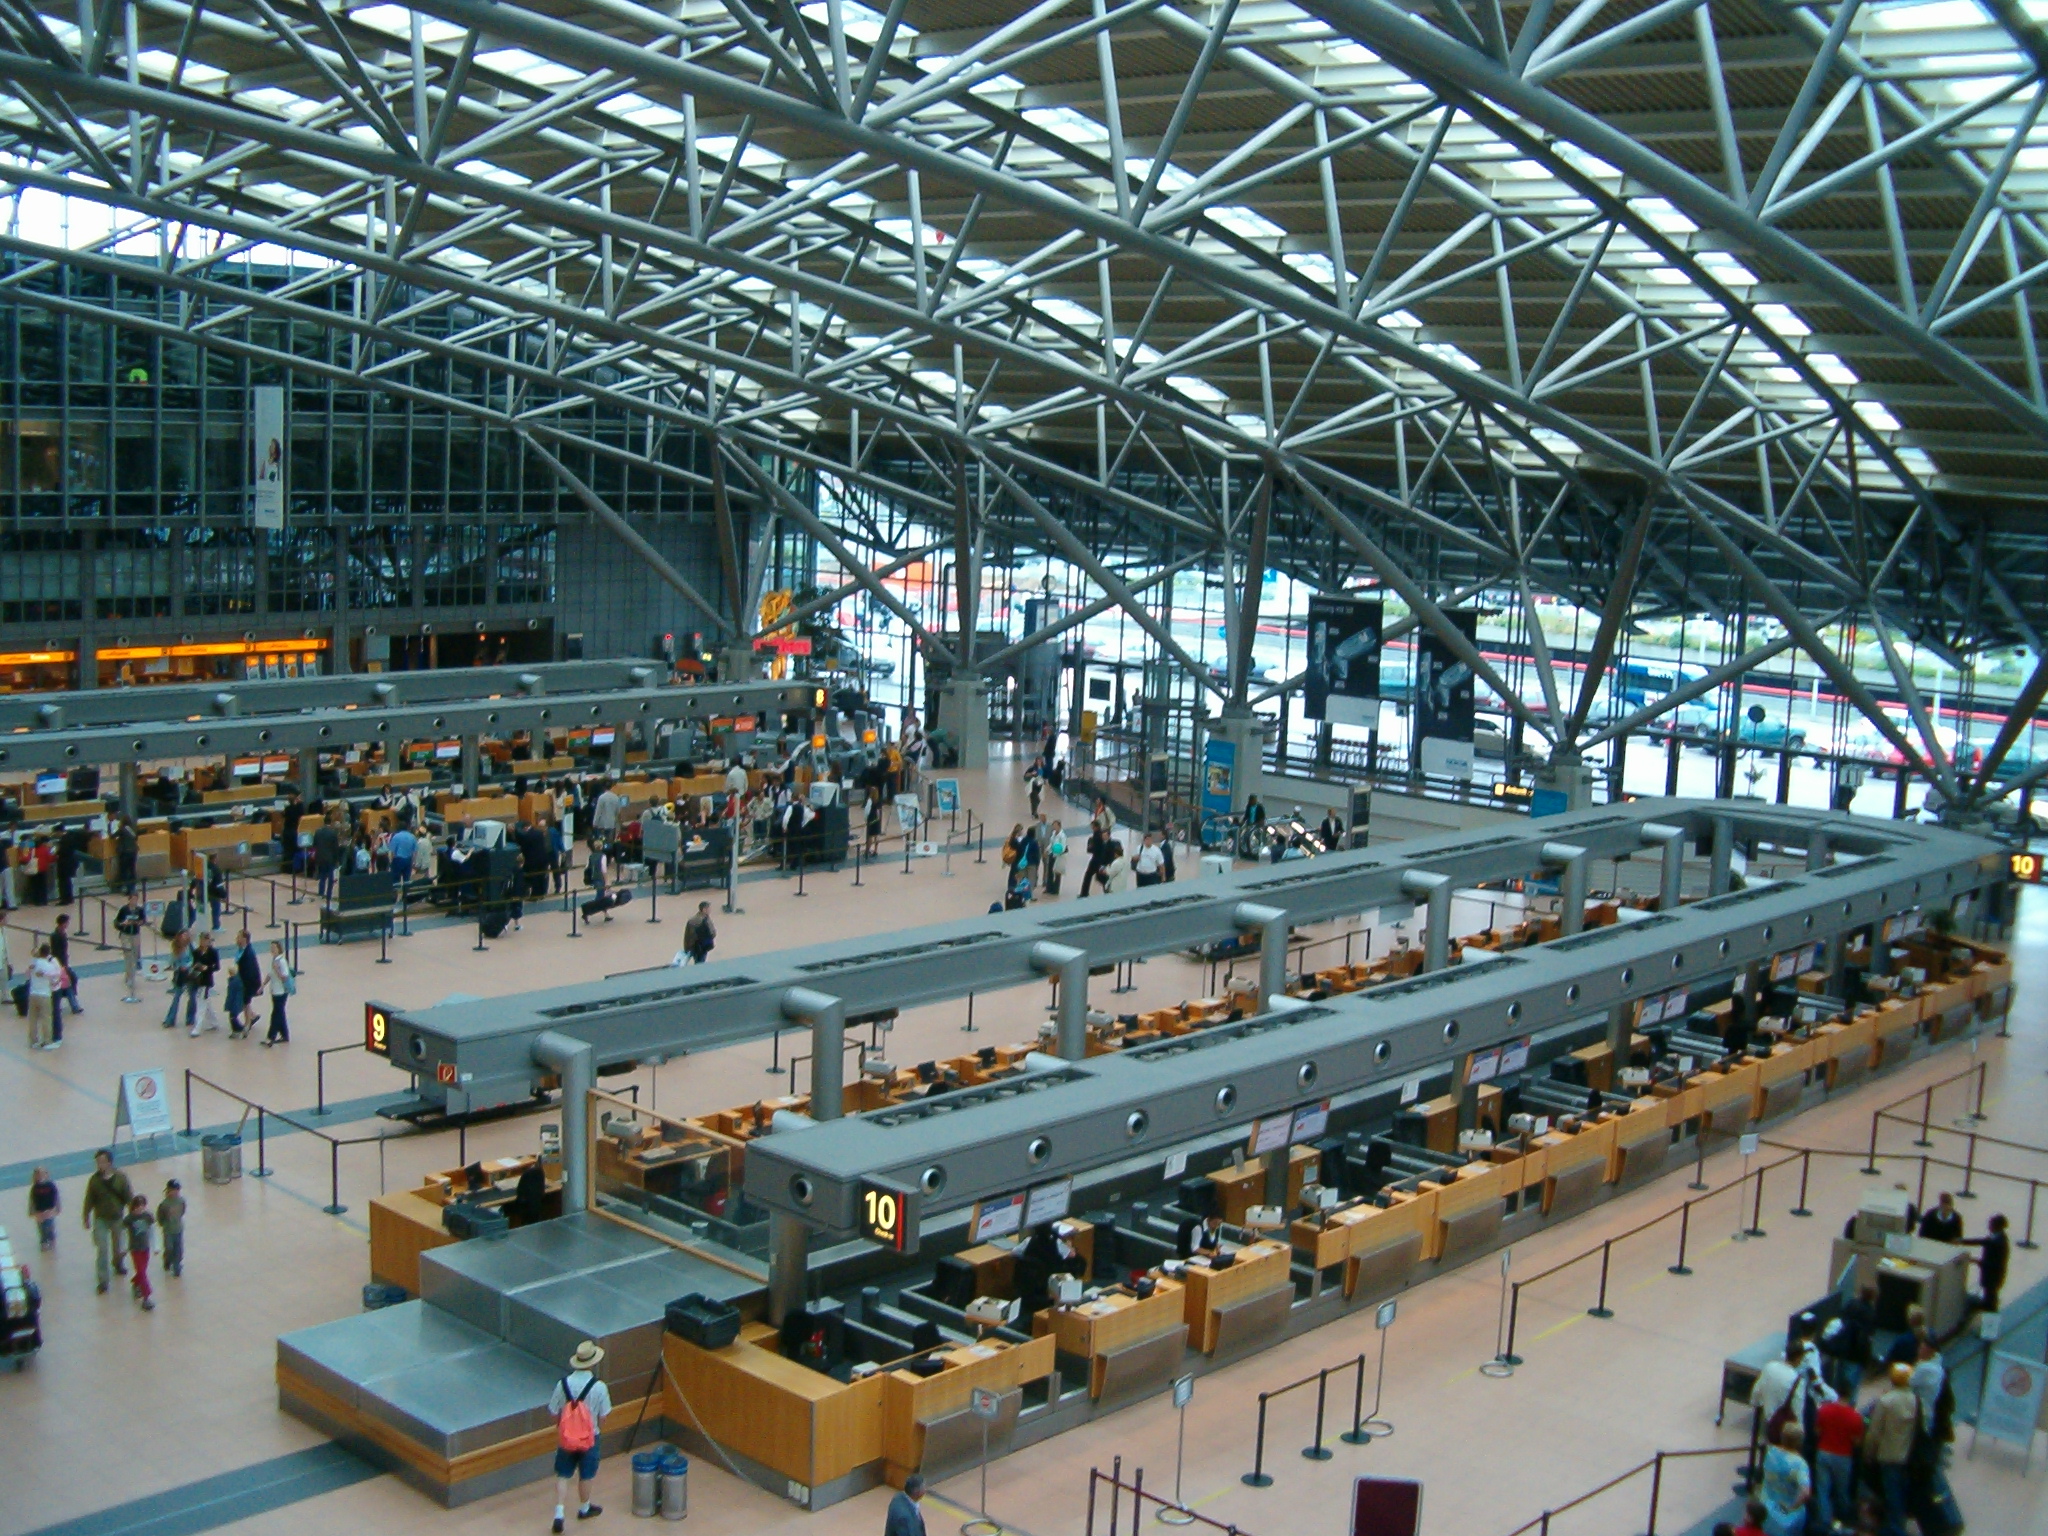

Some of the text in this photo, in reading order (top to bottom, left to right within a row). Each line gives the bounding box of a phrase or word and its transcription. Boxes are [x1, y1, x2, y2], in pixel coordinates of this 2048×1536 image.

[2011, 854, 2034, 874] 10
[372, 1013, 386, 1041] 9
[865, 1190, 896, 1230] 10
